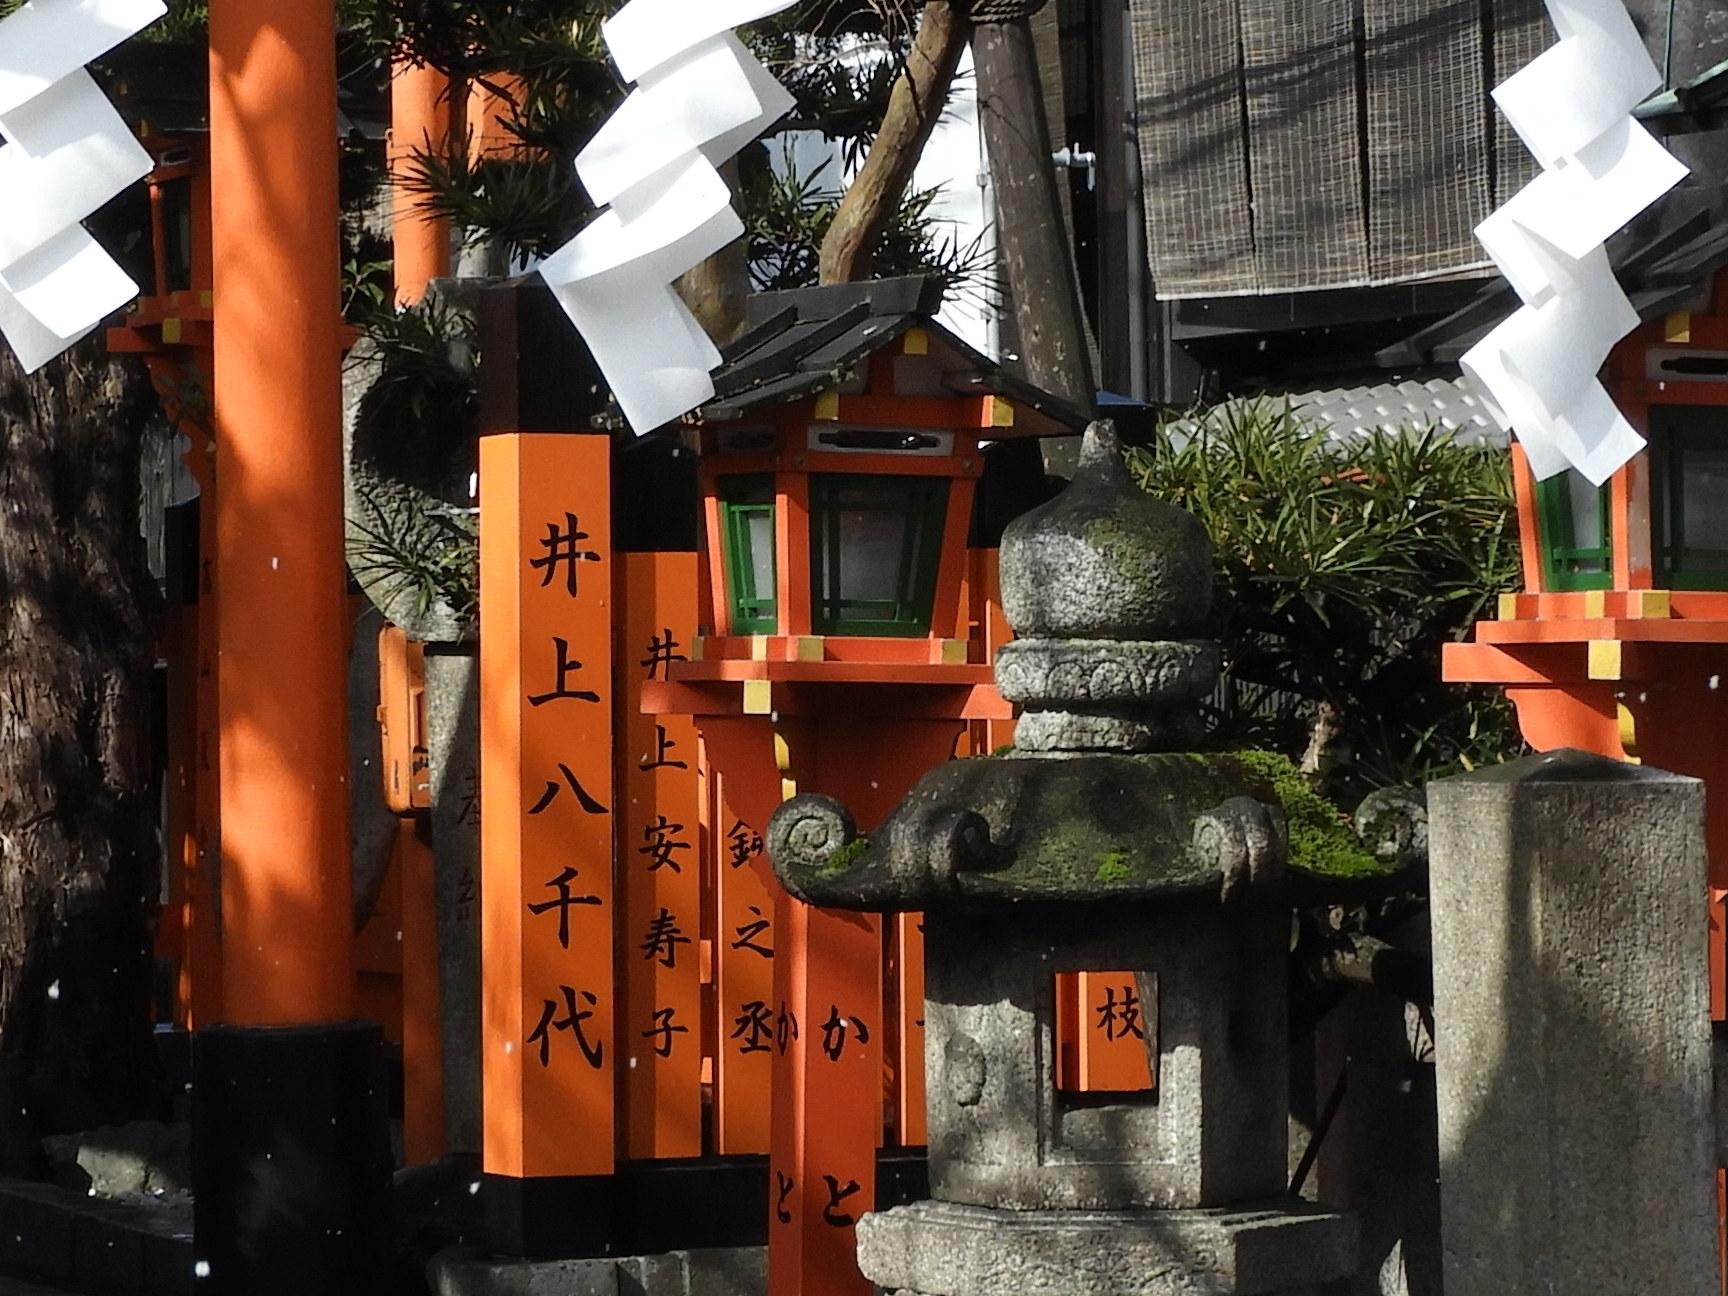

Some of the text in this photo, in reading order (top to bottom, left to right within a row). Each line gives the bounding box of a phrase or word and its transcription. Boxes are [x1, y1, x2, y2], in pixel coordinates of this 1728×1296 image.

[525, 510, 610, 1070] 井上八千代
[638, 627, 693, 1059] 井上安寿子
